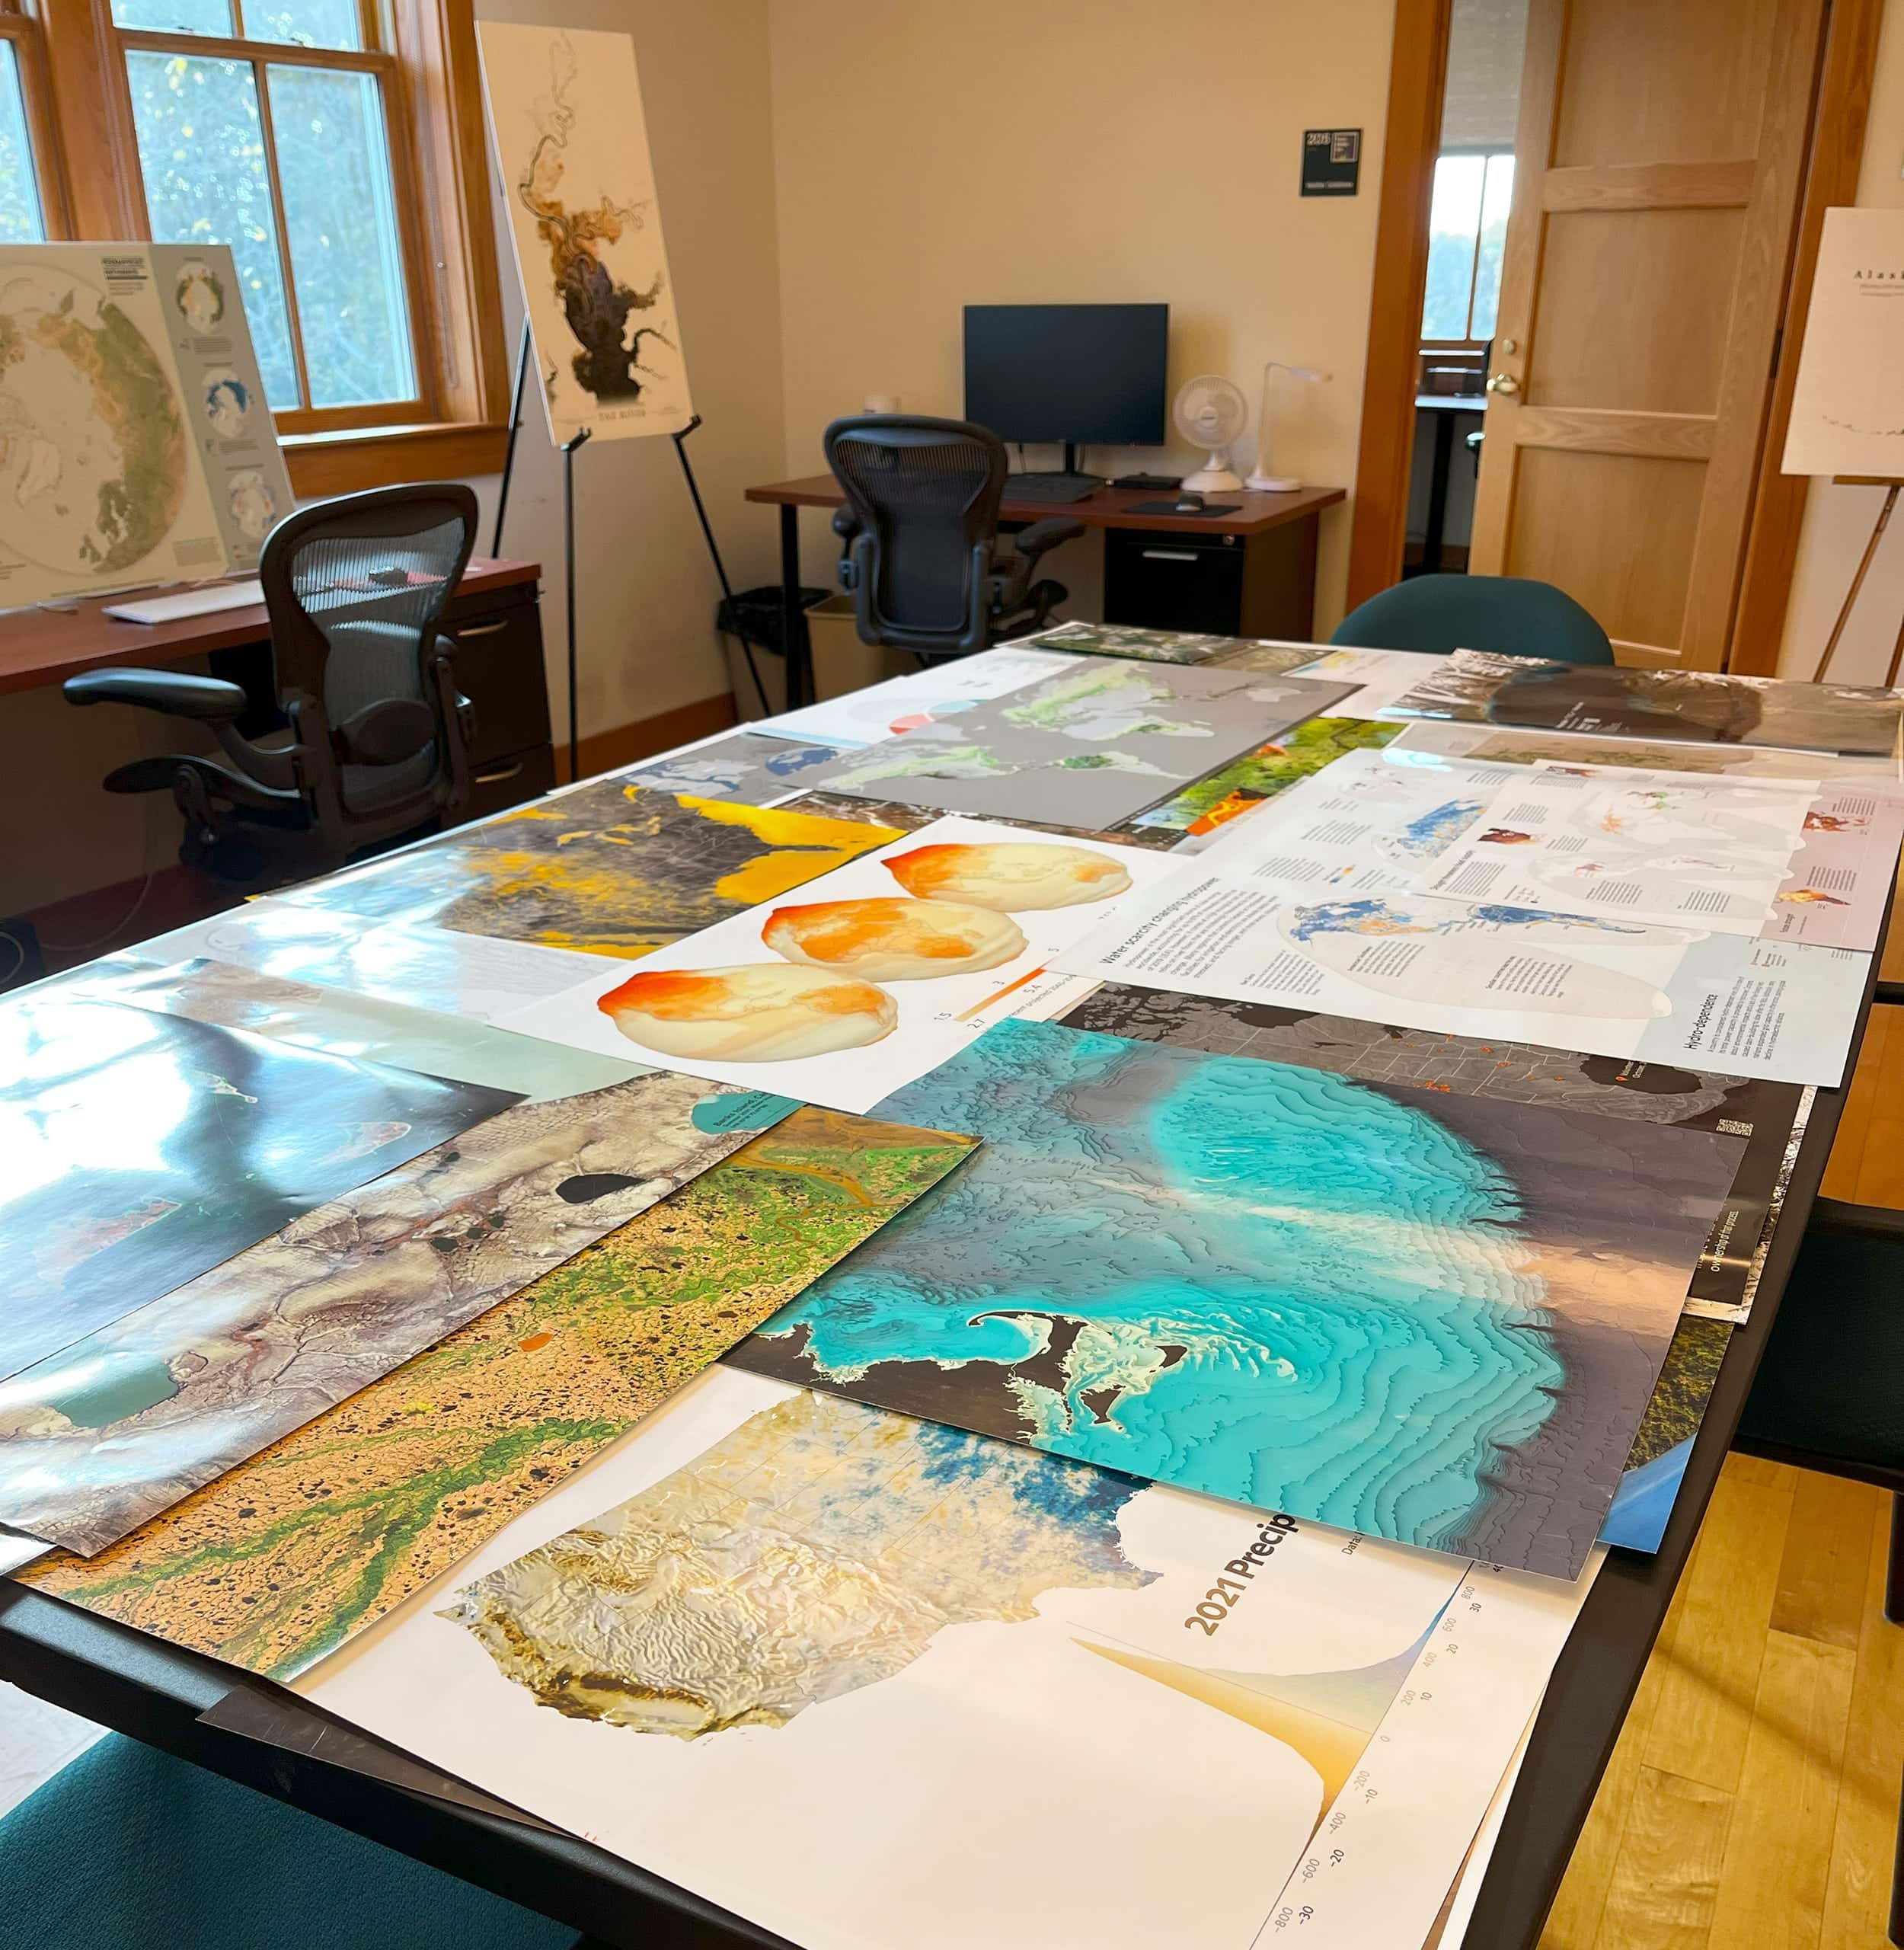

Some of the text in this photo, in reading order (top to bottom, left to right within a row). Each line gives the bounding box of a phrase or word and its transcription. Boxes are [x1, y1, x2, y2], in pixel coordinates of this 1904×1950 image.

[1100, 944, 1127, 964] Water
[1126, 920, 1158, 946] scarcity
[1683, 993, 1718, 1050] Hydro-dependence
[1711, 1239, 1730, 1272] ownership
[1341, 1535, 1363, 1555] Data:
[1184, 1514, 1299, 1636] 2021 Precip
[1462, 1586, 1475, 1600] 800
[1469, 1603, 1481, 1613] 30
[1442, 1617, 1456, 1632] 600
[1446, 1644, 1458, 1654] 20
[1423, 1652, 1437, 1668] 400
[1401, 1689, 1417, 1706] 200
[1421, 1691, 1433, 1702] 10
[1329, 1811, 1347, 1835] -400
[1330, 1849, 1345, 1868] -20
[1302, 1858, 1320, 1884] -600
[1274, 1907, 1293, 1933] -800
[1299, 1905, 1314, 1926] -30
